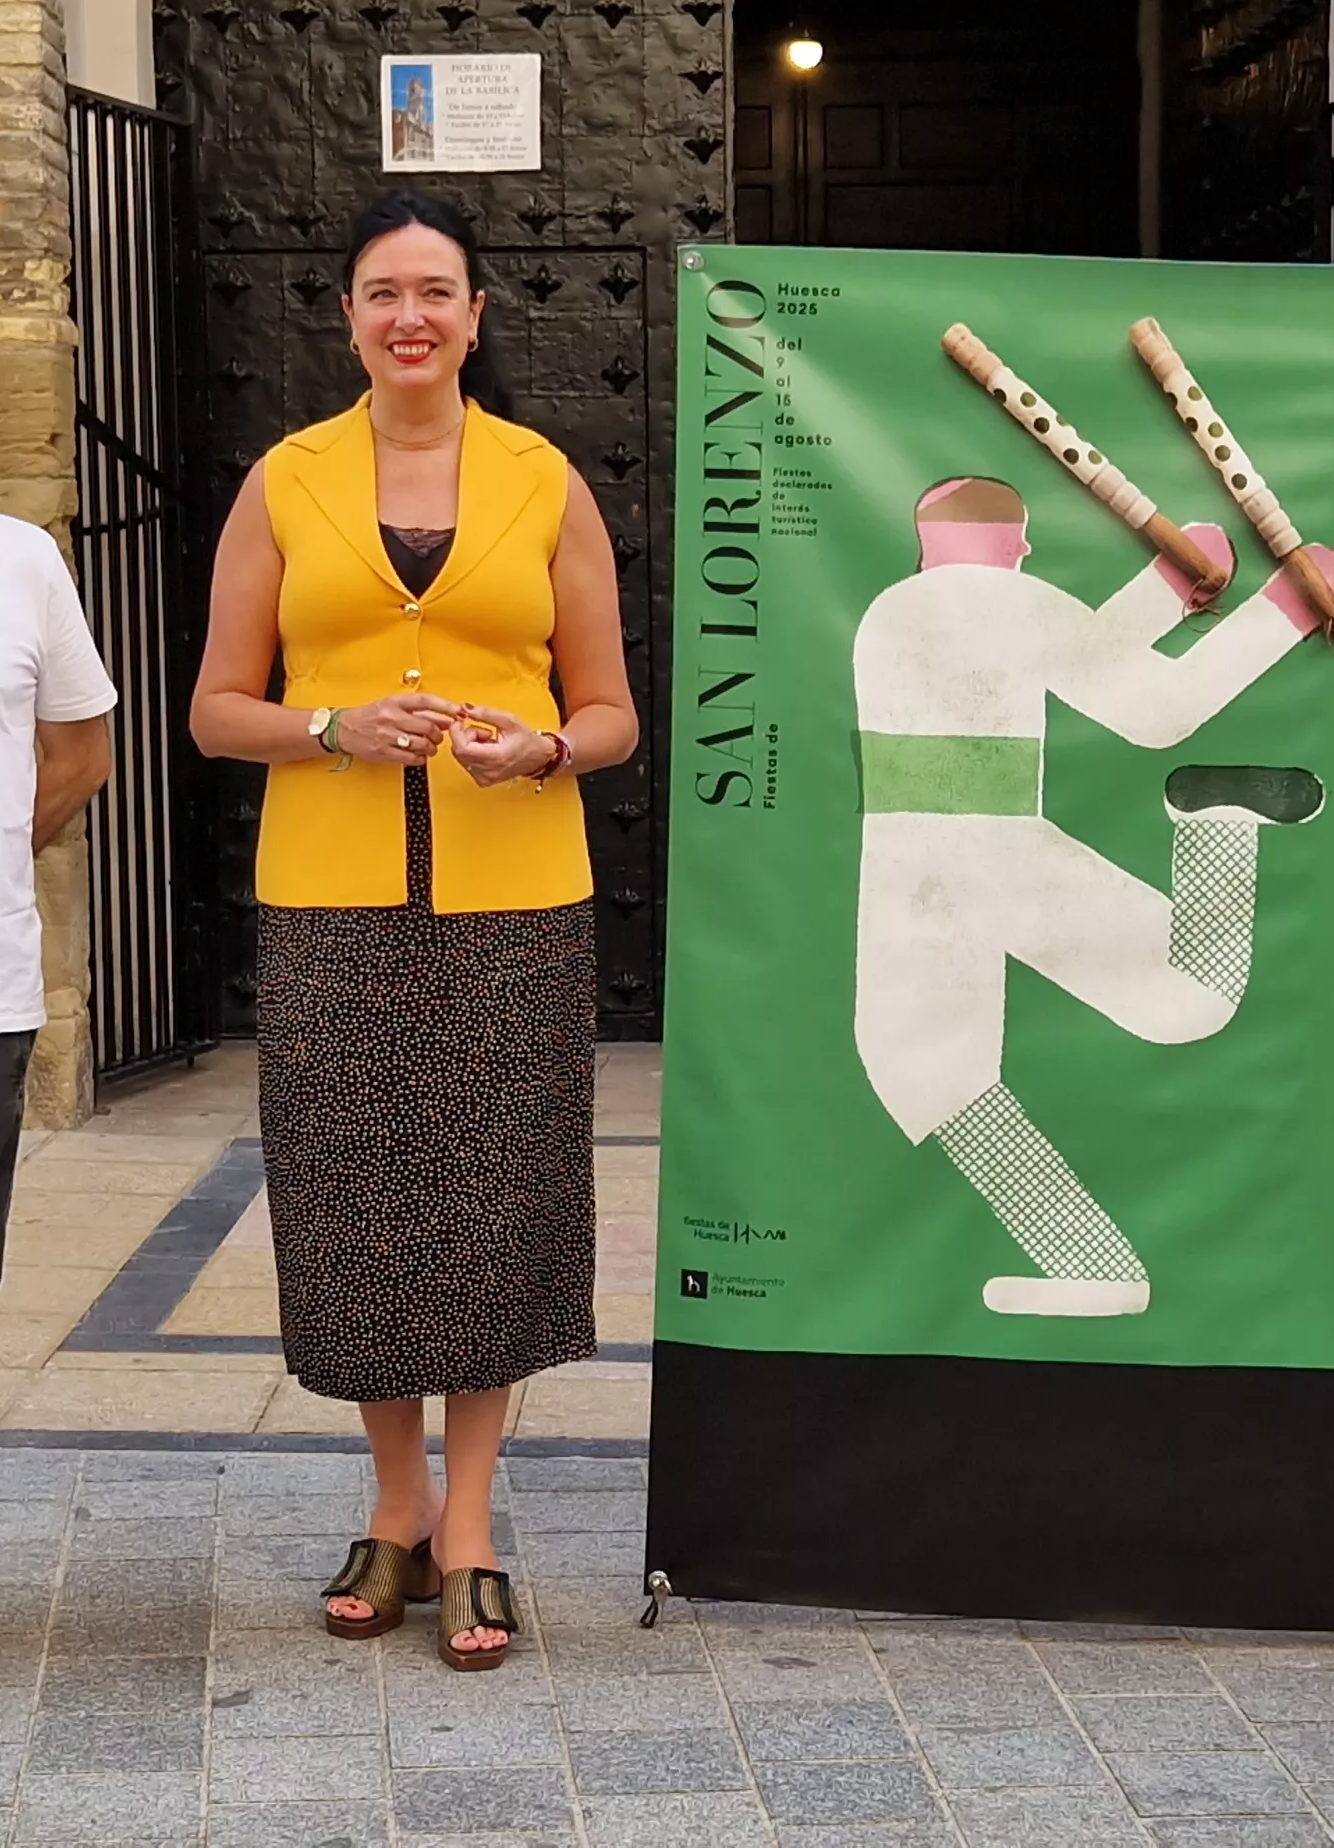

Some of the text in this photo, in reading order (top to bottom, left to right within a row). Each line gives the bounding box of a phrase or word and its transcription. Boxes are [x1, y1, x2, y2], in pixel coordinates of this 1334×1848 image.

[461, 87, 473, 95] LA
[777, 283, 841, 297] Huesca
[777, 302, 818, 316] 2025
[776, 337, 803, 351] del
[776, 356, 785, 369] 9
[776, 375, 791, 388] al
[775, 394, 792, 407] 15
[774, 412, 795, 426] de
[774, 432, 833, 447] agosto
[772, 490, 785, 500] de
[695, 279, 767, 808] SAN LORENZO
[762, 723, 779, 809] Fiestas de
[726, 1285, 767, 1298] Huesca
